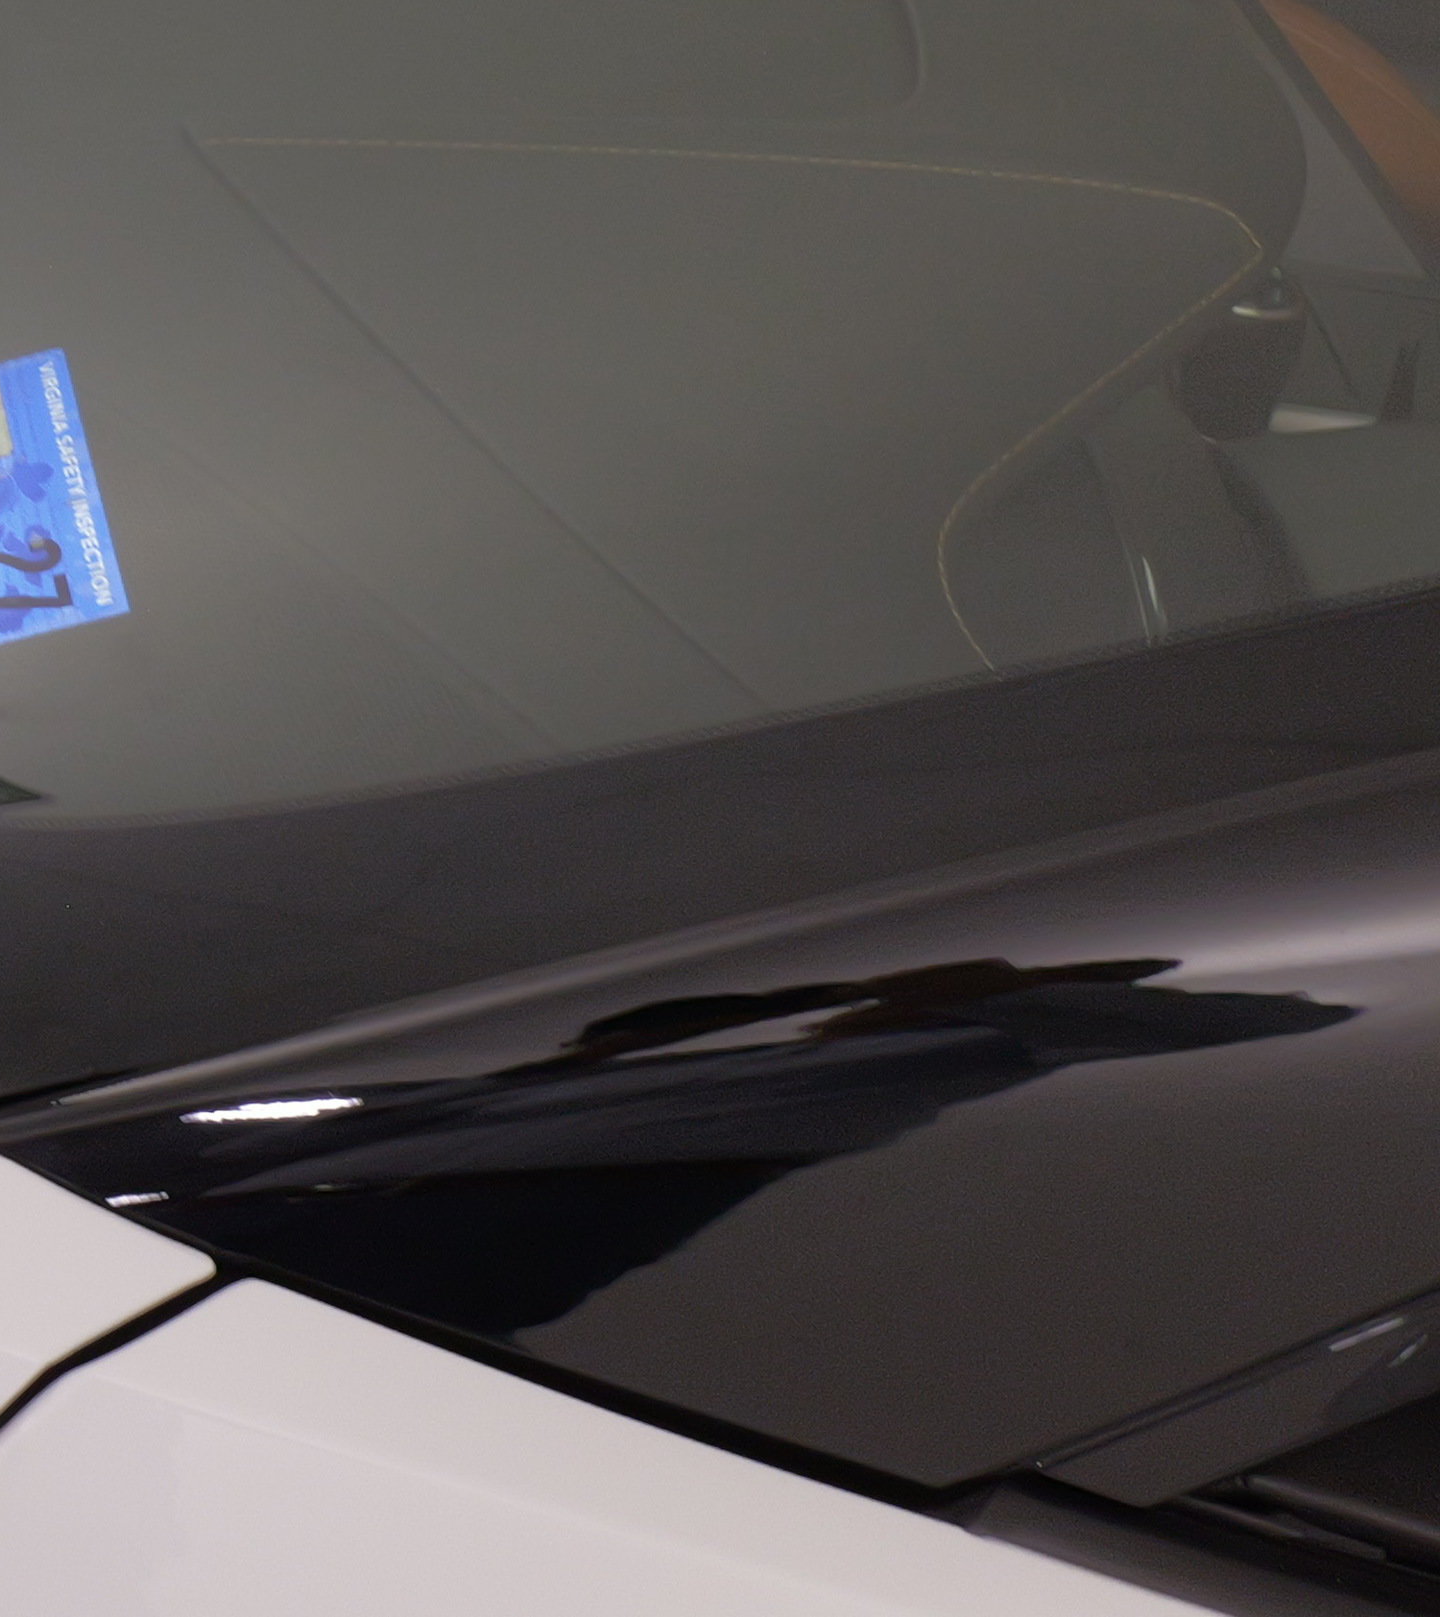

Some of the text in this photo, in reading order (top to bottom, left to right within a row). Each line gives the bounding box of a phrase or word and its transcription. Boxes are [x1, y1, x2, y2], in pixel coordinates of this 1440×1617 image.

[34, 360, 114, 608] VIRGINIA SAFETY INSPECTION
